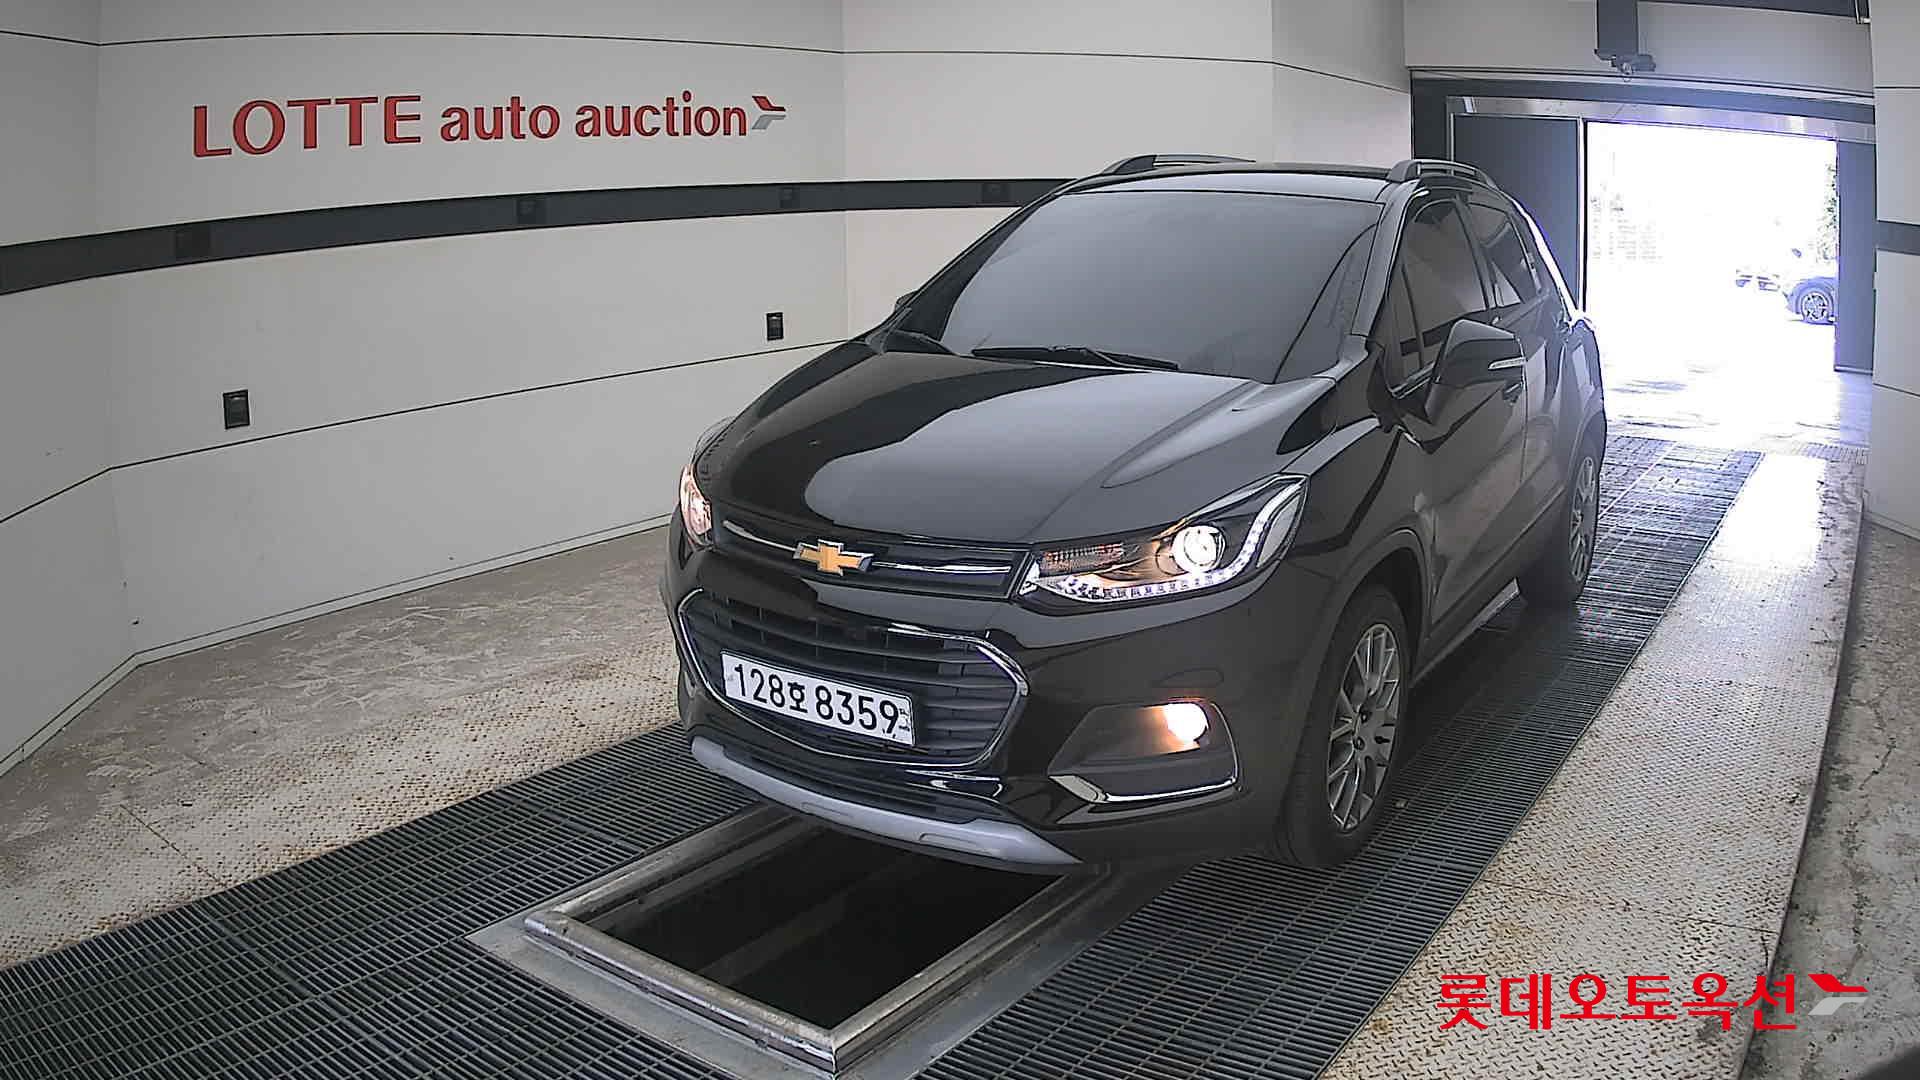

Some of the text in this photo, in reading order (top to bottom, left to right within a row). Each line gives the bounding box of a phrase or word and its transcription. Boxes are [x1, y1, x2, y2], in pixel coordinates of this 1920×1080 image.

[193, 91, 748, 157] LOTTE auto auction
[735, 664, 808, 713] 128호
[815, 685, 899, 734] 8359
